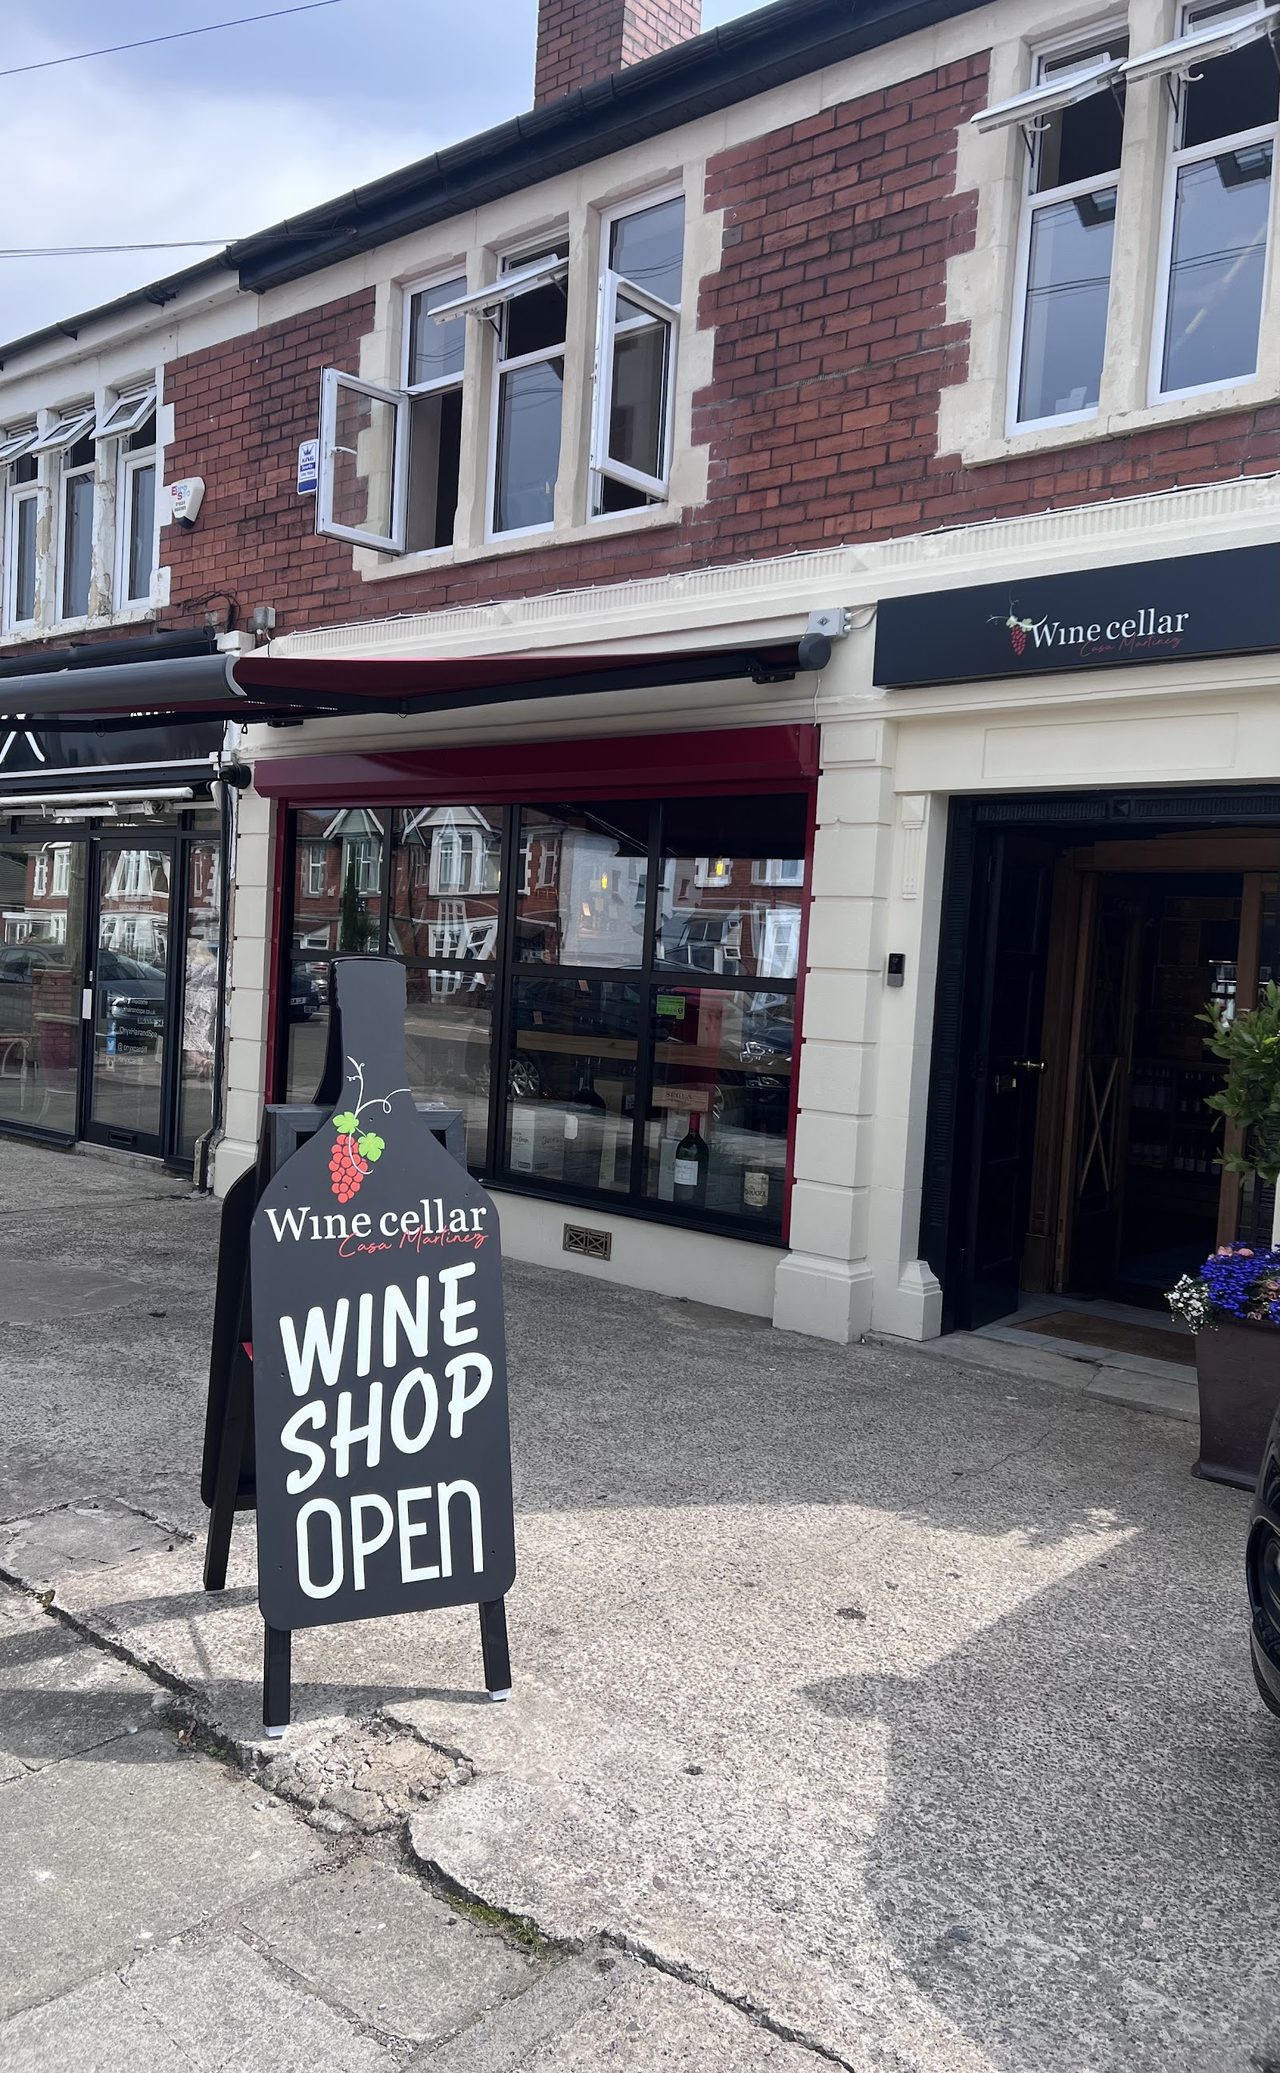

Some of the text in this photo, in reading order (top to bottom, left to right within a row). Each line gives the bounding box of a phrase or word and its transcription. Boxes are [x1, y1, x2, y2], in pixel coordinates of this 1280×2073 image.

[1032, 608, 1189, 648] Wine cellar
[1118, 634, 1185, 653] Martinez
[264, 1198, 487, 1243] Wine cellar
[338, 1224, 488, 1258] Casa Martinez
[279, 1261, 479, 1397] WINE
[280, 1352, 493, 1495] SHOP
[296, 1479, 484, 1599] OPEN
